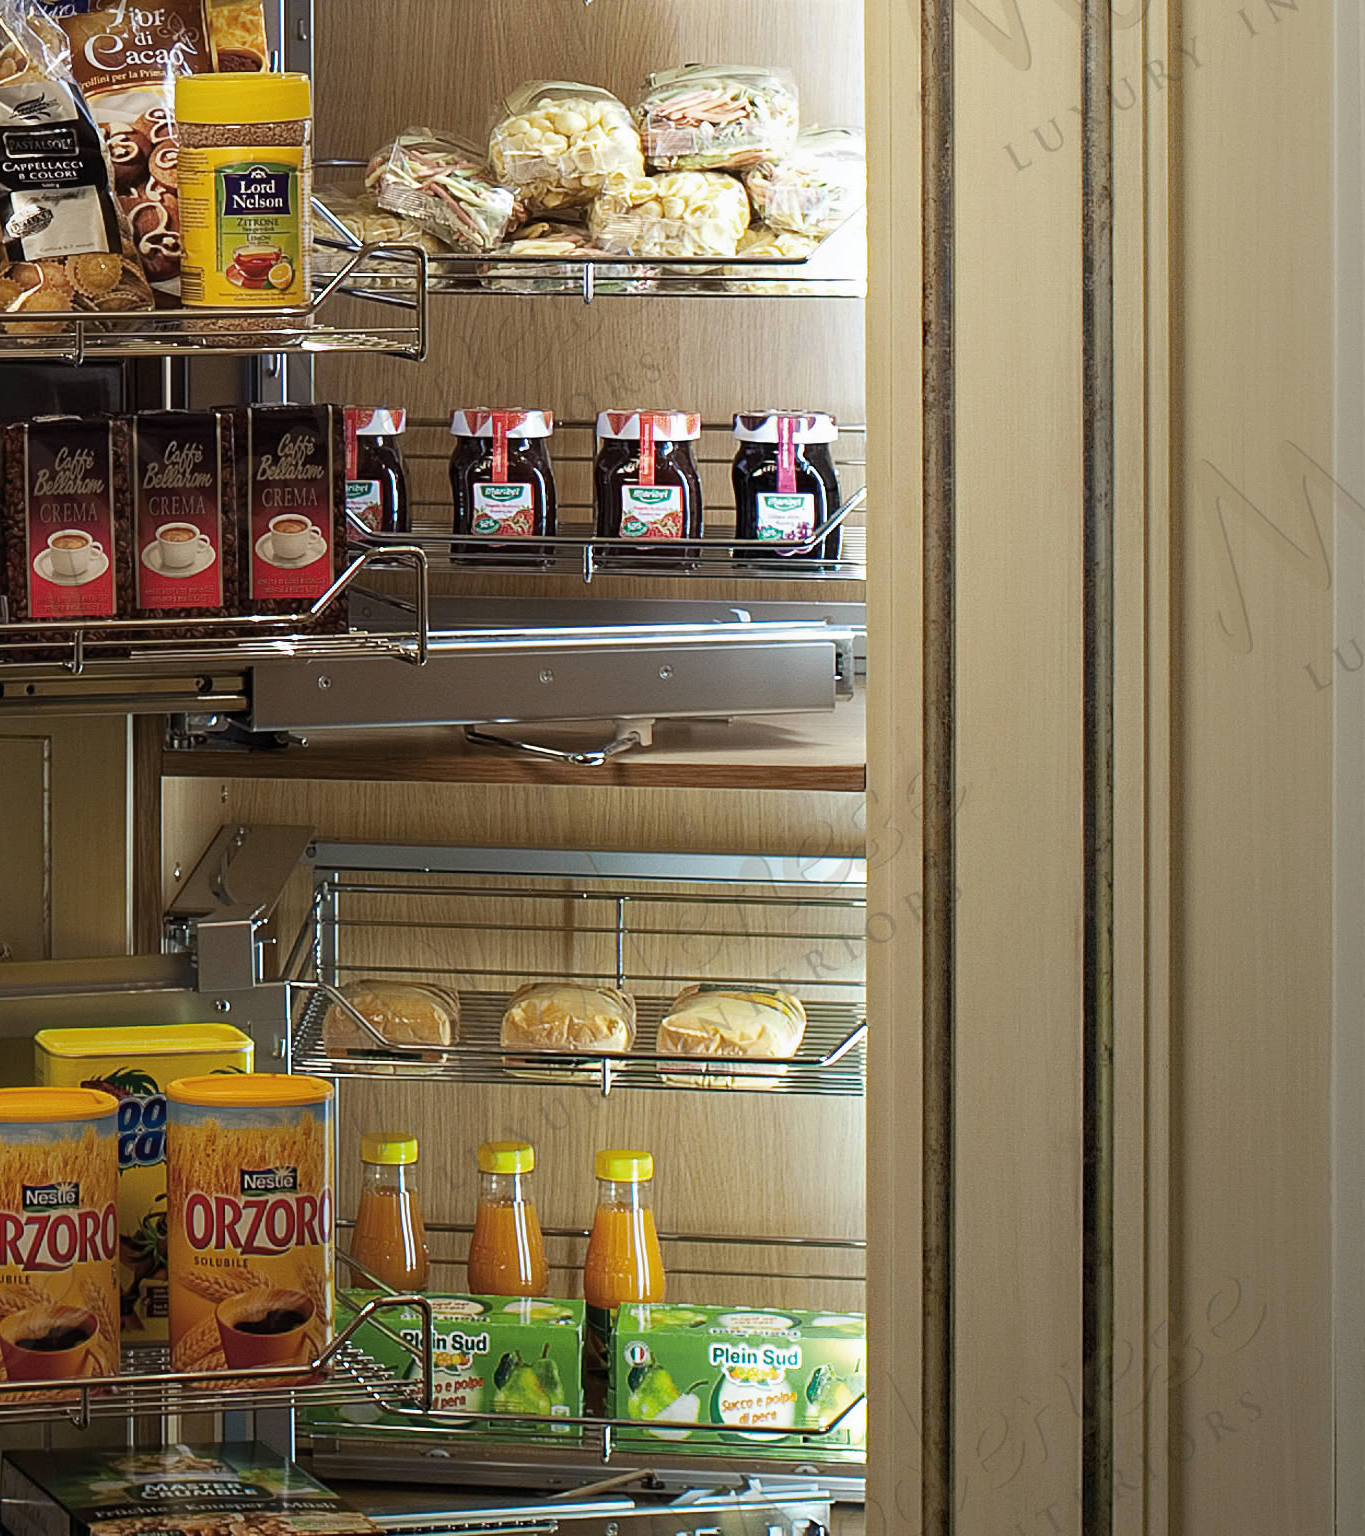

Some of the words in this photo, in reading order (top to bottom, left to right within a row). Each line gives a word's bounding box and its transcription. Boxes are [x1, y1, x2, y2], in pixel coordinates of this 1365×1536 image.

[135, 31, 153, 45] di
[84, 33, 185, 71] Cacao
[111, 71, 127, 84] per
[129, 70, 138, 79] la
[2, 160, 84, 173] CAPPELLACCI
[29, 171, 77, 180] COLORI
[239, 180, 276, 194] Lord
[232, 194, 284, 209] Nelson
[163, 440, 204, 473] Caffè
[277, 433, 316, 465] Caffè
[54, 446, 95, 477] Caffè
[261, 487, 319, 508] CREMA
[39, 503, 98, 523] CREMA
[148, 495, 207, 517] CREMA
[185, 1187, 333, 1256] ORZORO
[194, 1255, 249, 1269] SOLUBILE
[452, 1334, 487, 1351] Sud
[712, 1347, 758, 1364] Plein
[763, 1349, 798, 1365] Sud
[722, 1398, 753, 1411] Succo
[145, 1481, 243, 1491] MASTER
[140, 1489, 259, 1500] CRUMBLE
